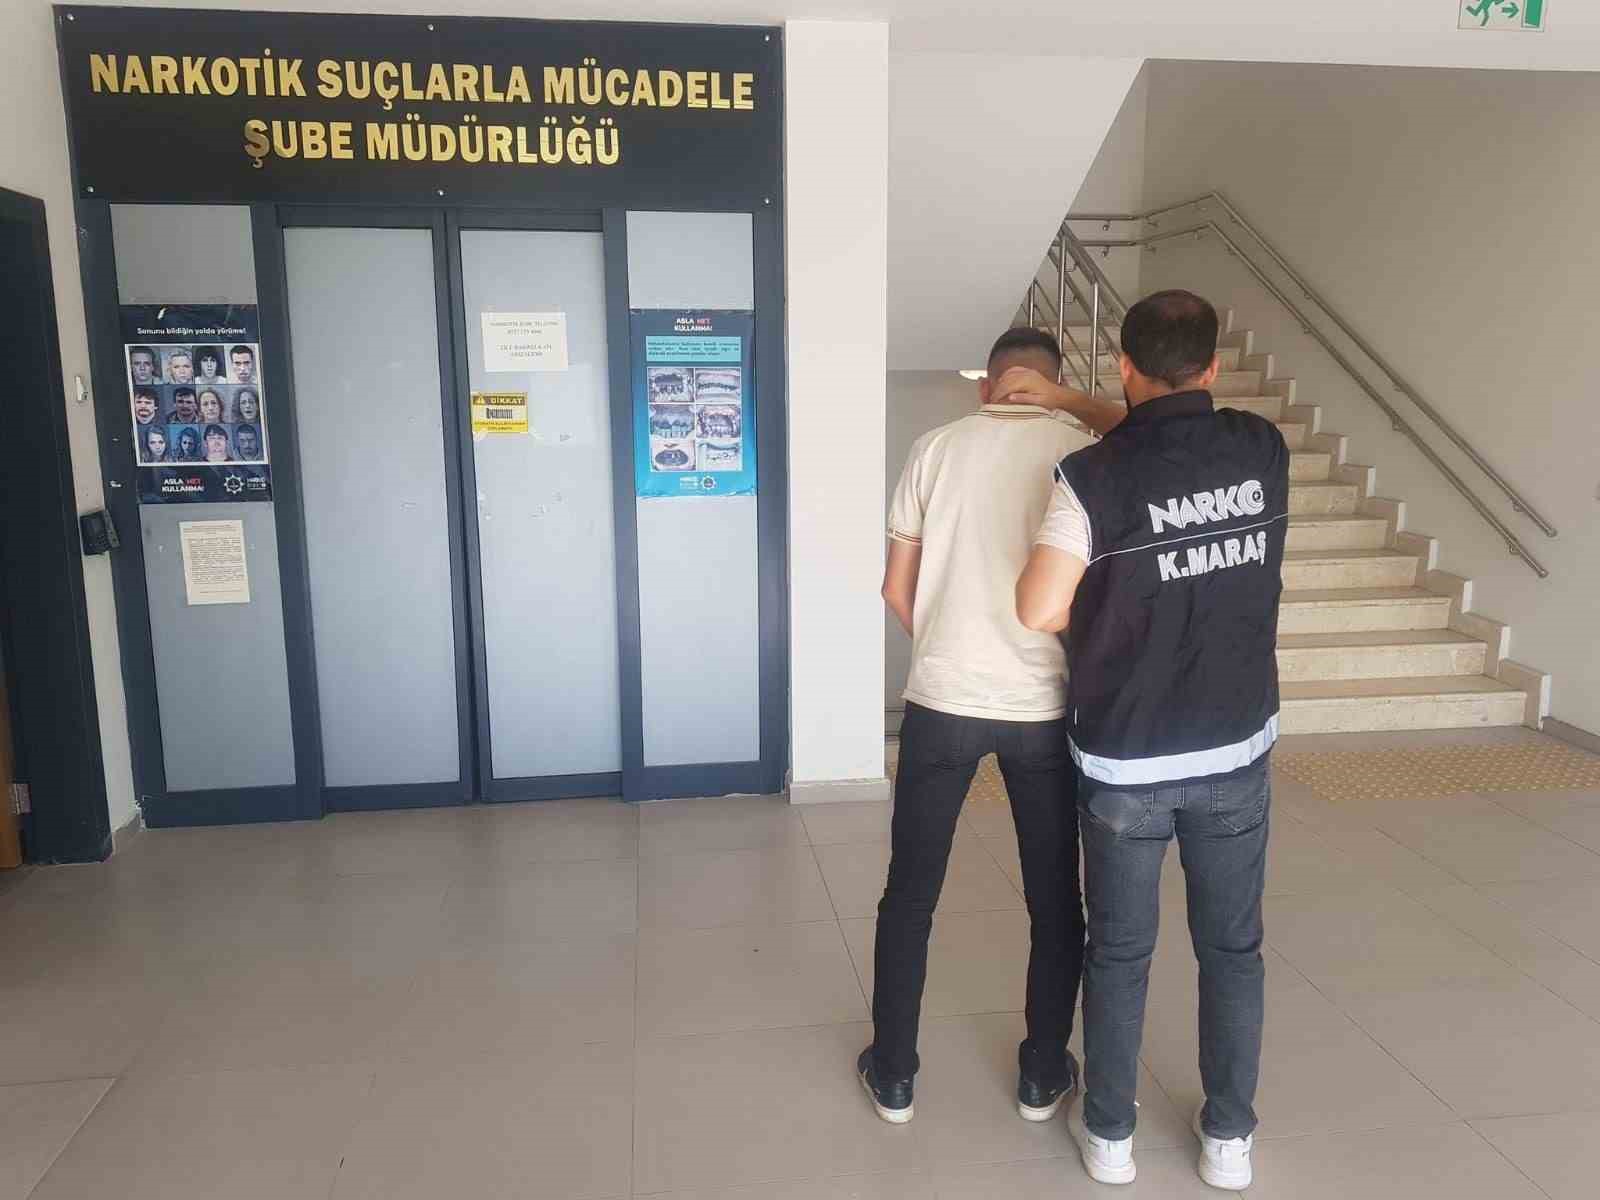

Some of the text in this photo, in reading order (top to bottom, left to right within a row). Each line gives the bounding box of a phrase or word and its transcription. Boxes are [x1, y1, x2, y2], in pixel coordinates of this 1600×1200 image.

[89, 48, 755, 111] NARKOTİK SUÇLARLA MÜCADELE
[243, 112, 621, 168] ŞUBE MÜDÜRLÜĞÜ
[1157, 531, 1266, 581] K.MARAŞ
